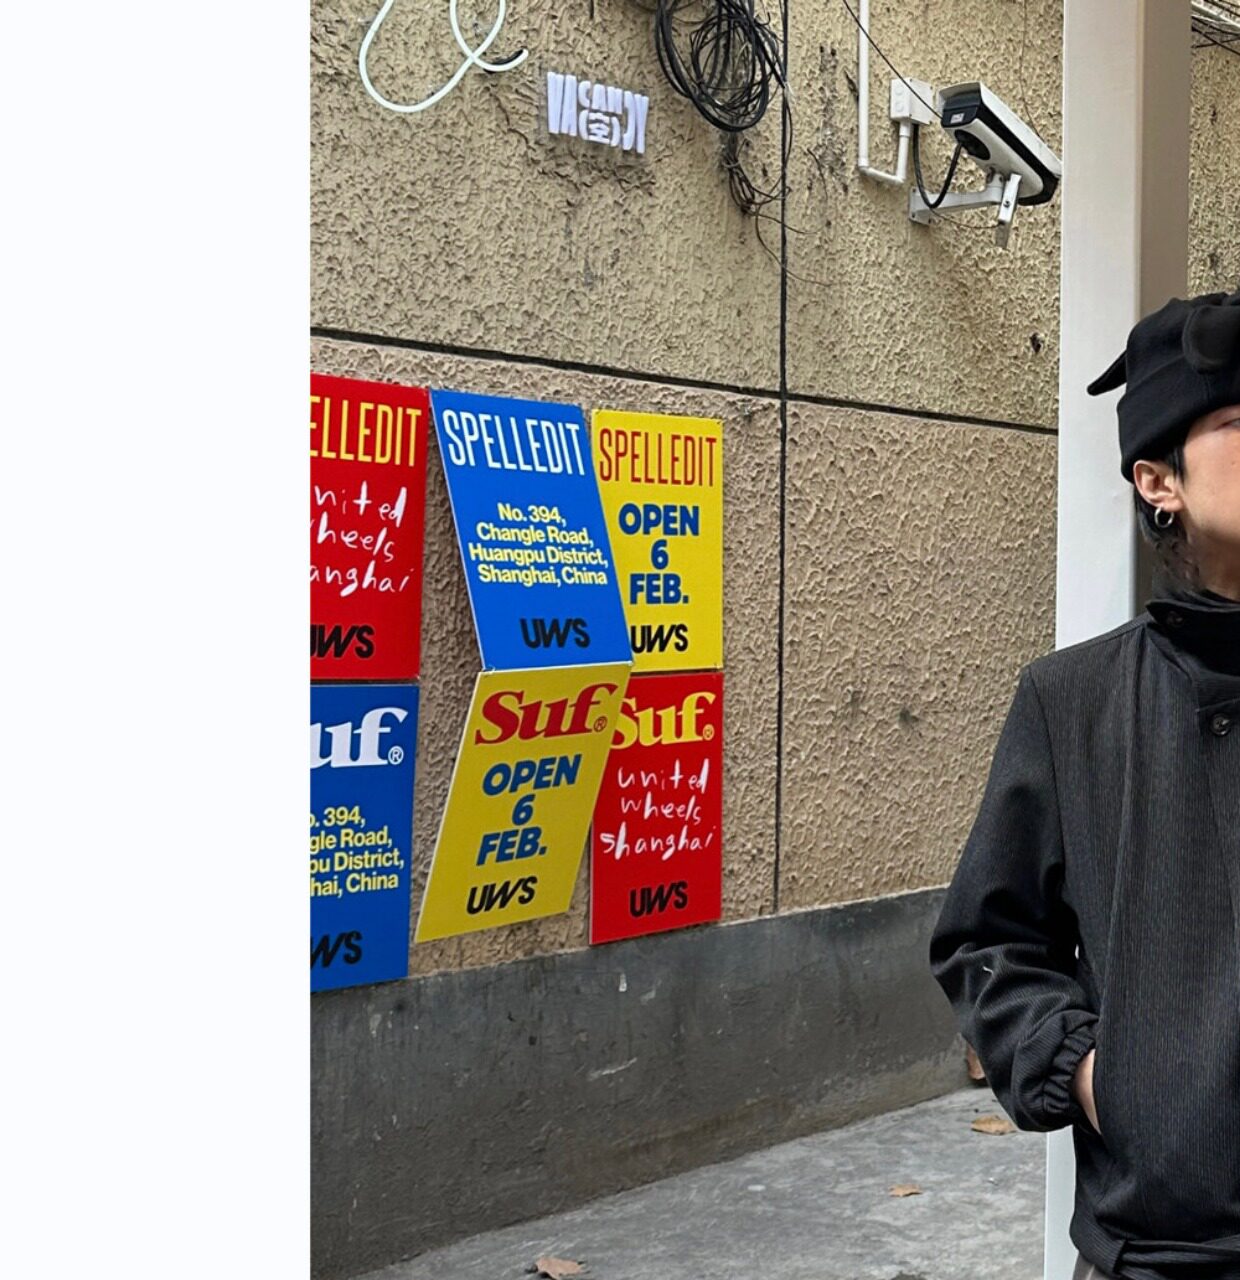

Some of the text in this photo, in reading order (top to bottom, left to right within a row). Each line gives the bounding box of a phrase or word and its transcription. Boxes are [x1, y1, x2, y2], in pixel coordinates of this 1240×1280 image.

[442, 409, 585, 476] SPELLEDIT
[599, 428, 717, 487] SPELLEDIT
[497, 502, 567, 528] No. 394,
[618, 503, 700, 536] OPEN
[310, 511, 395, 562] heels
[476, 521, 595, 548] Changle Road,
[468, 542, 609, 569] Huangpu District,
[651, 539, 669, 570] 6
[477, 563, 608, 588] Shanghai, China
[629, 573, 690, 605] FEB.
[519, 617, 591, 649] UWS
[630, 623, 689, 654] UWS
[482, 753, 582, 796] OPEN
[617, 758, 710, 795] united
[323, 805, 366, 828] 394,
[512, 793, 536, 826] 6
[621, 791, 702, 826] wheels
[340, 825, 392, 848] Road,
[476, 826, 548, 866] FEB.
[600, 820, 717, 861] shanghai
[334, 848, 404, 872] District,
[345, 871, 399, 893] China
[467, 875, 538, 915] UWS
[629, 880, 688, 918] UWS
